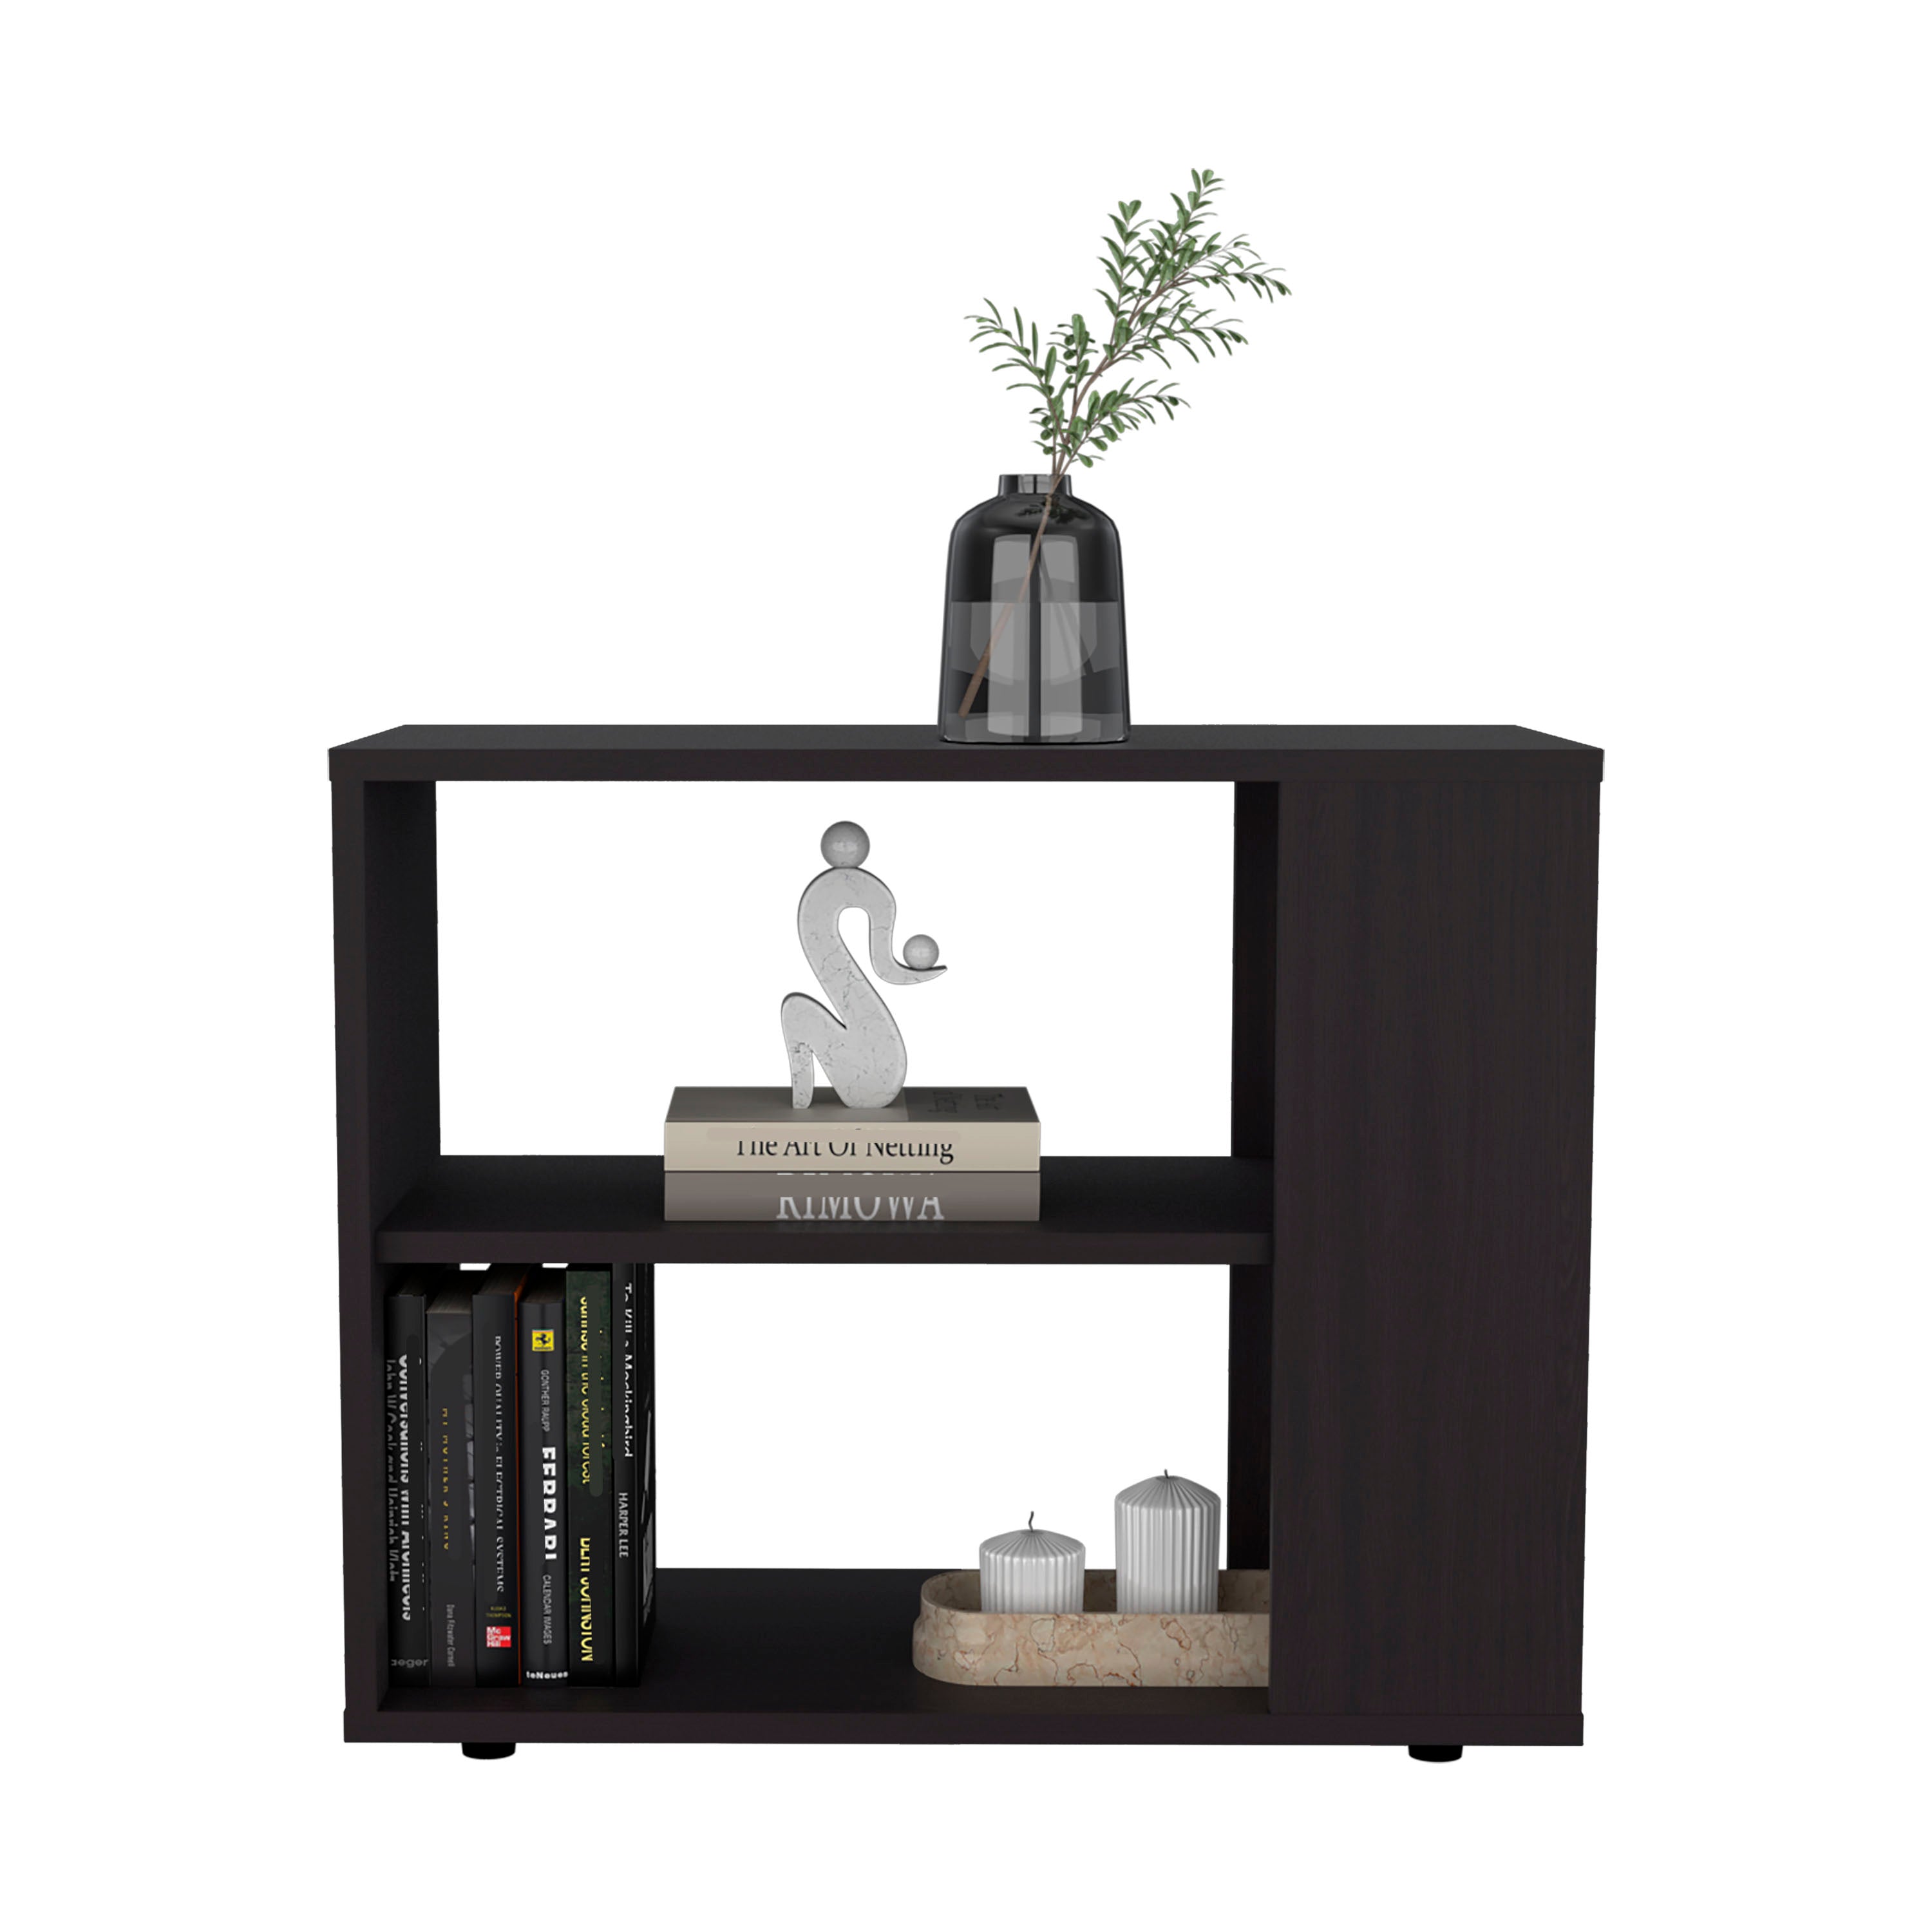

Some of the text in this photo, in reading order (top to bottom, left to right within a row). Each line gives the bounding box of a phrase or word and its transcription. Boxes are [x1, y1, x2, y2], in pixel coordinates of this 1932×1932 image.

[618, 1492, 630, 1558] HARPER LEE
[542, 1574, 552, 1615] CALENDAR
